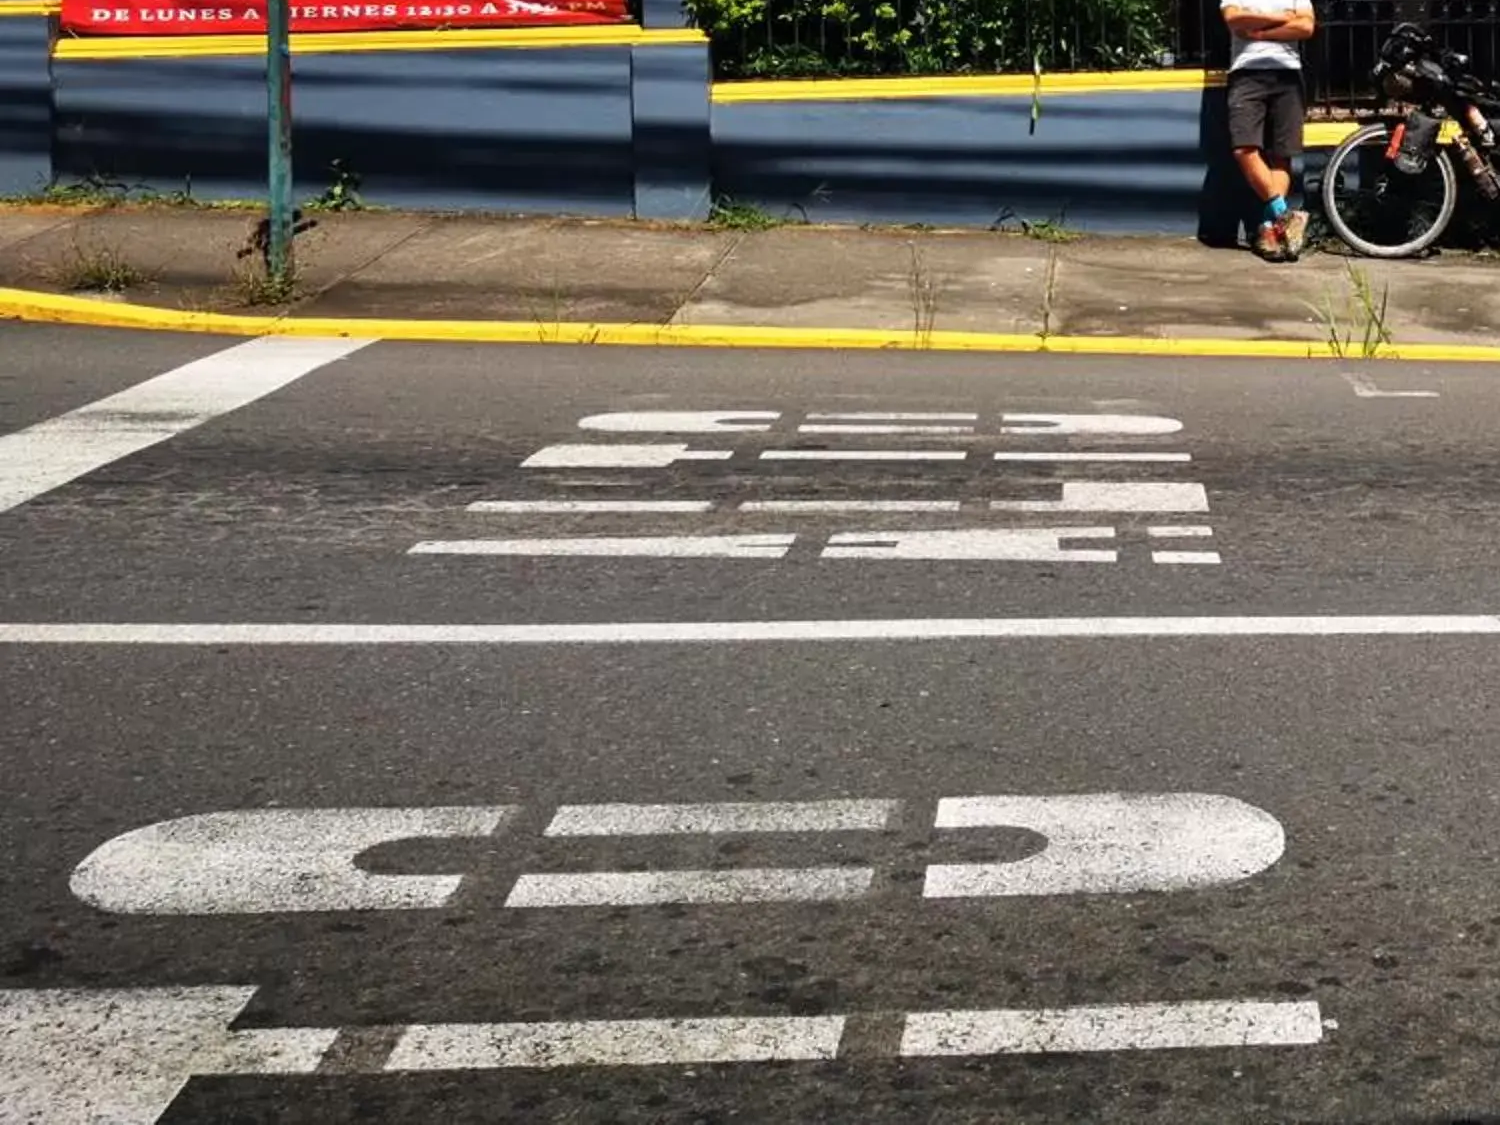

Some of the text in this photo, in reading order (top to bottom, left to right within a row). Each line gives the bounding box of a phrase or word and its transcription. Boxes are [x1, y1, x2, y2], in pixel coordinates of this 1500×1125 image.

[92, 7, 129, 22] DE
[140, 6, 233, 22] LUNES
[243, 7, 260, 20] A
[288, 3, 397, 19] IERNES
[405, 4, 473, 17] 12:30
[480, 2, 499, 15] A
